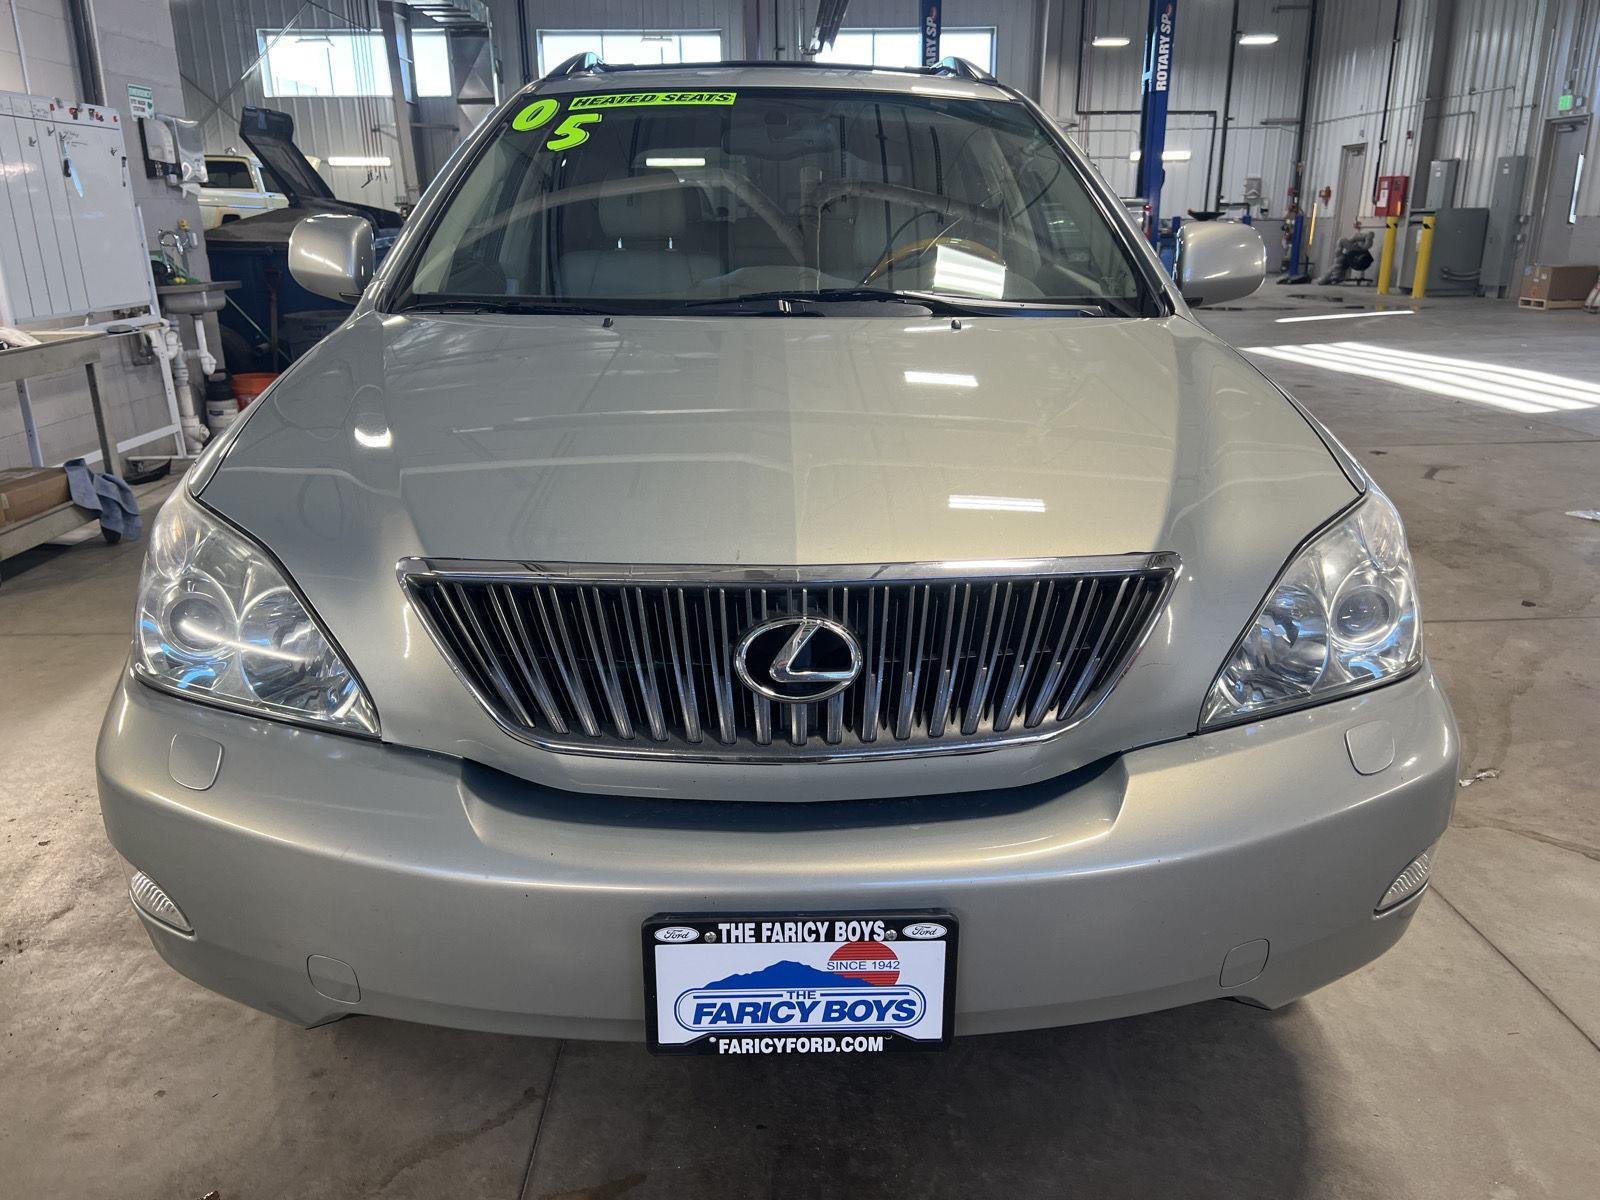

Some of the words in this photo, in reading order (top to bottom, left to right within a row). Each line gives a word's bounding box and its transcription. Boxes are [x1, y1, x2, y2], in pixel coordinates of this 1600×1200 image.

[1155, 35, 1170, 91] ROTARY
[572, 94, 658, 107] HEATED
[661, 92, 733, 103] SEATS
[663, 929, 690, 940] Ford
[718, 922, 756, 943] THE
[761, 921, 830, 943] FARICY
[834, 920, 886, 942] BOYS
[911, 926, 938, 936] Ford
[826, 961, 867, 971] SINCE
[871, 960, 900, 970] 1942
[786, 989, 817, 1000] THE
[693, 1000, 821, 1025] FARICY
[821, 999, 917, 1023] BOYS
[718, 1036, 884, 1055] FARICYFORD.COM
